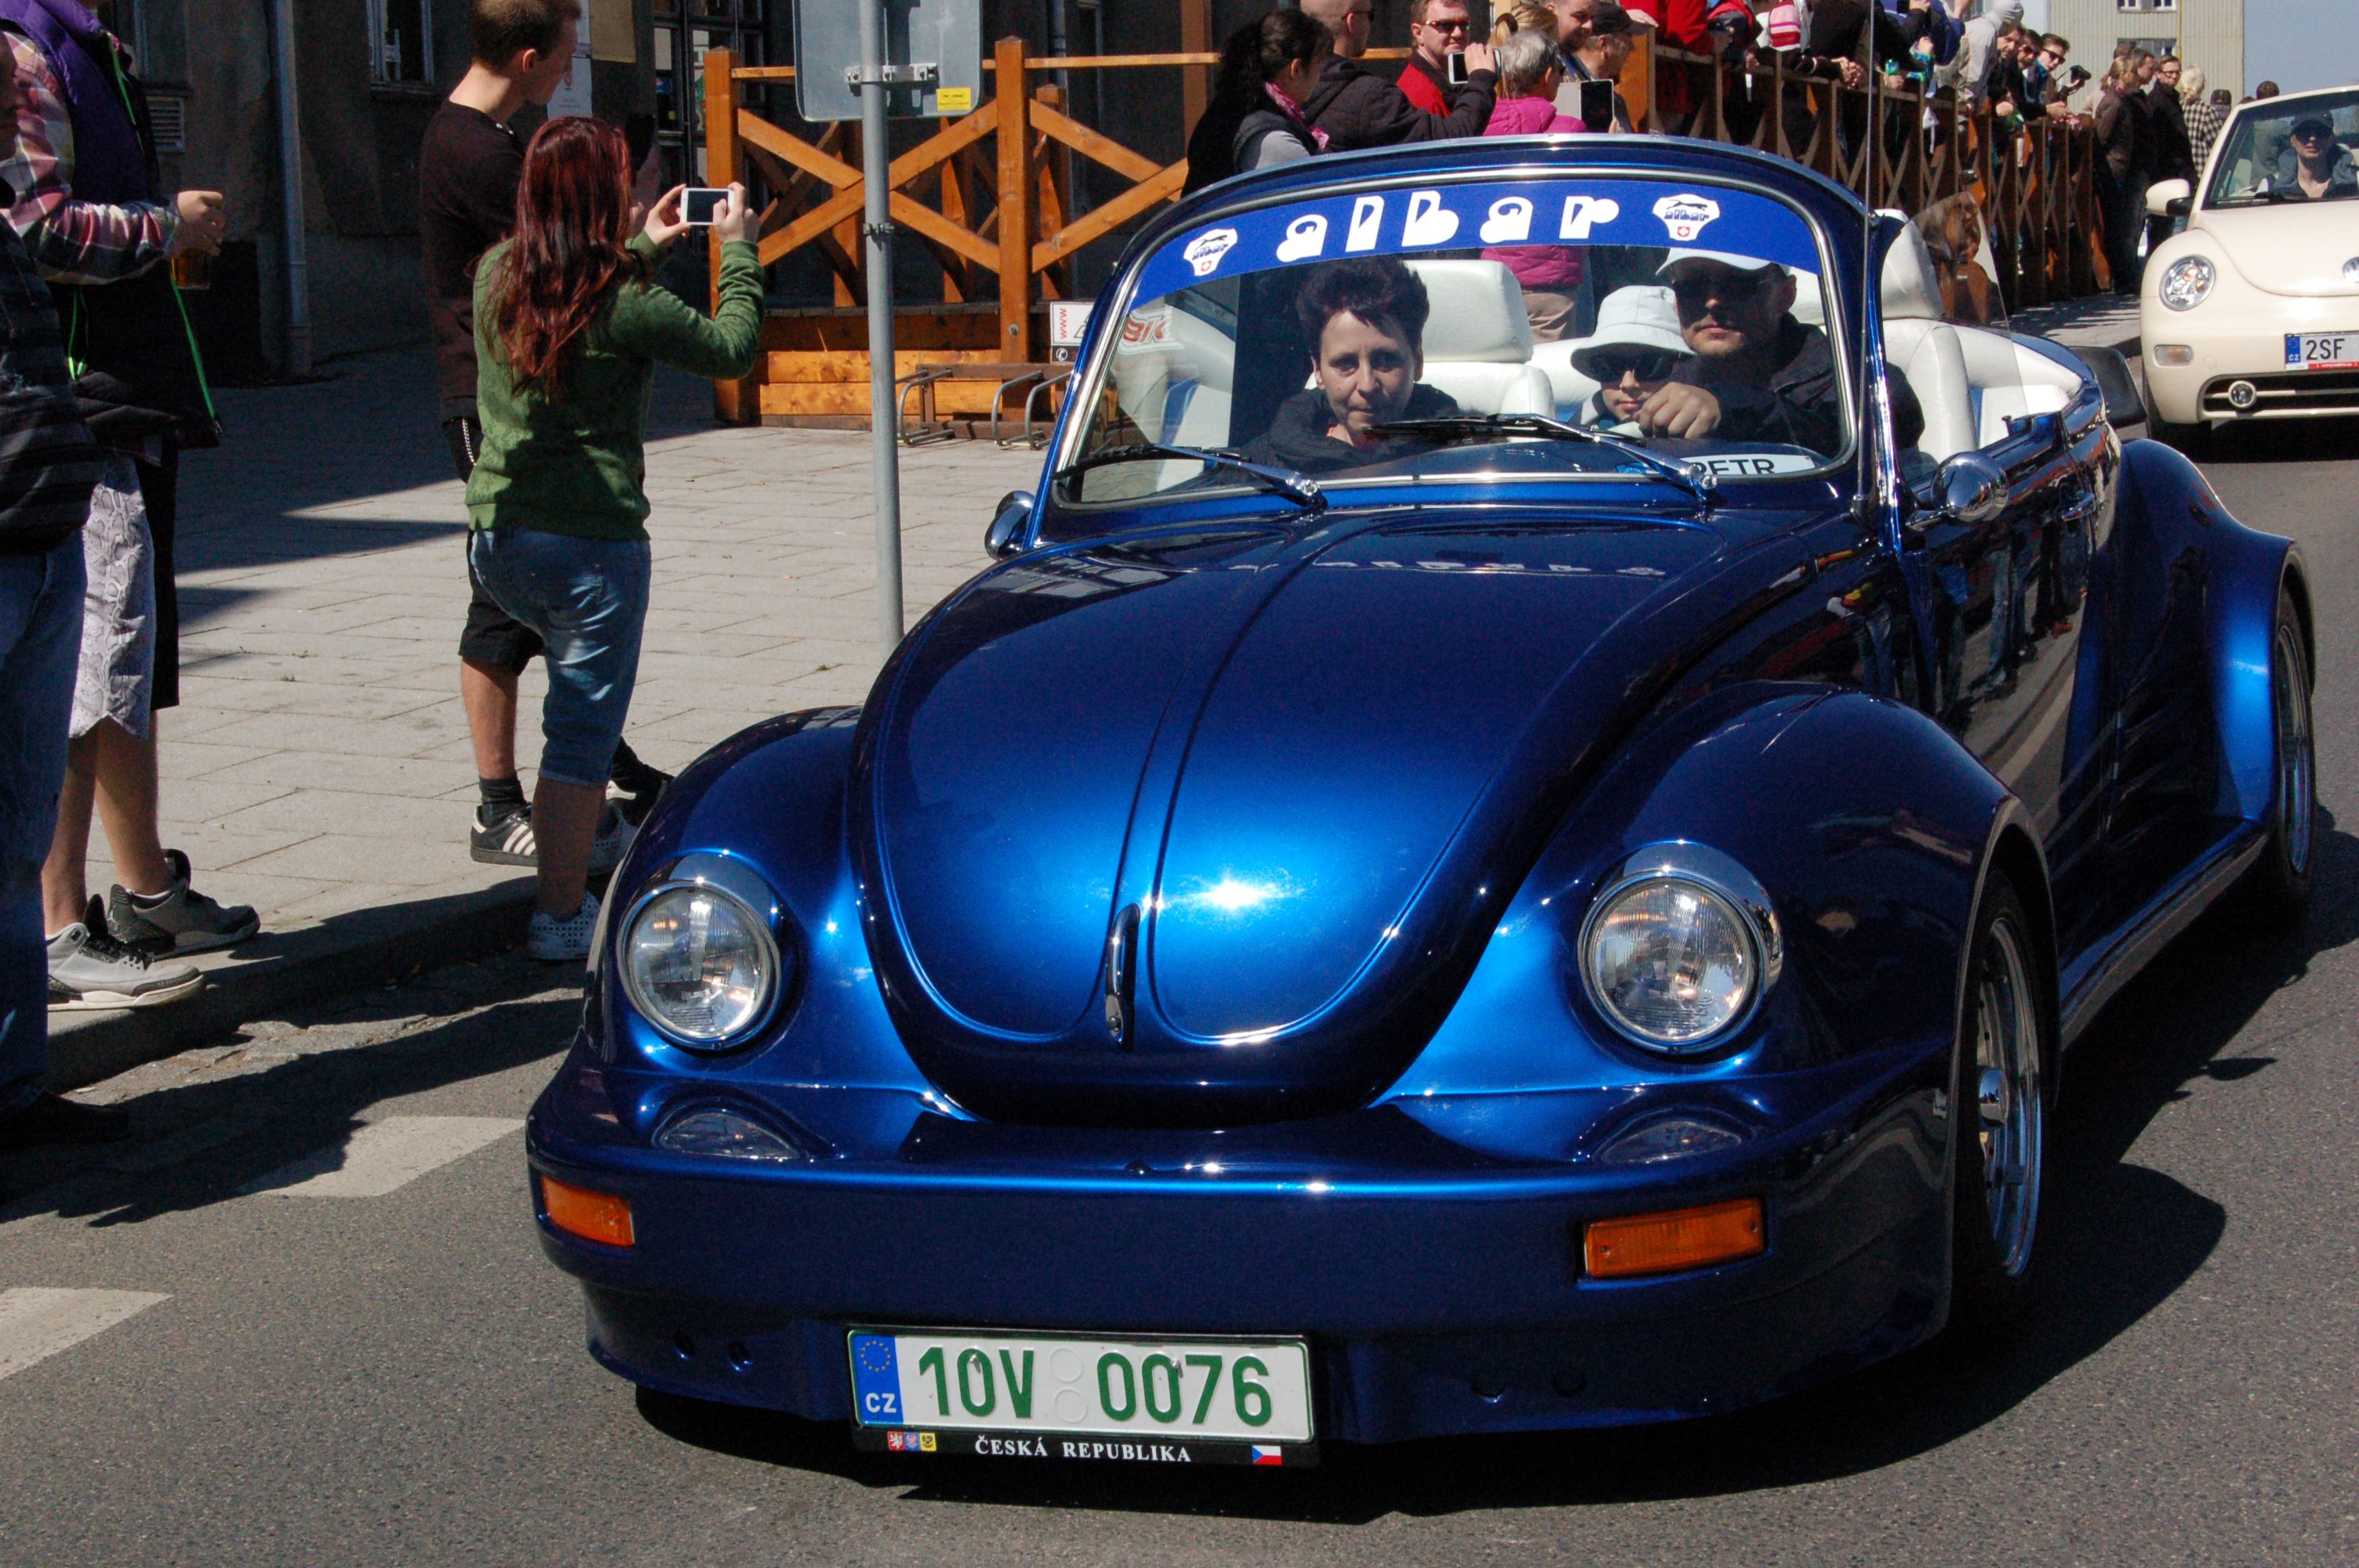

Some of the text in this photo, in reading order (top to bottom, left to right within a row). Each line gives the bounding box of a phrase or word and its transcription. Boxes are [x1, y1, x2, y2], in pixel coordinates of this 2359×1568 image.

[1276, 190, 1619, 262] albar
[1664, 209, 1710, 222] albar
[2306, 338, 2345, 361] 2SF
[918, 1346, 1272, 1428] 10V 0076
[865, 1392, 897, 1414] CZ
[975, 1435, 1191, 1463] ČESKÁ REPUBLIKA
